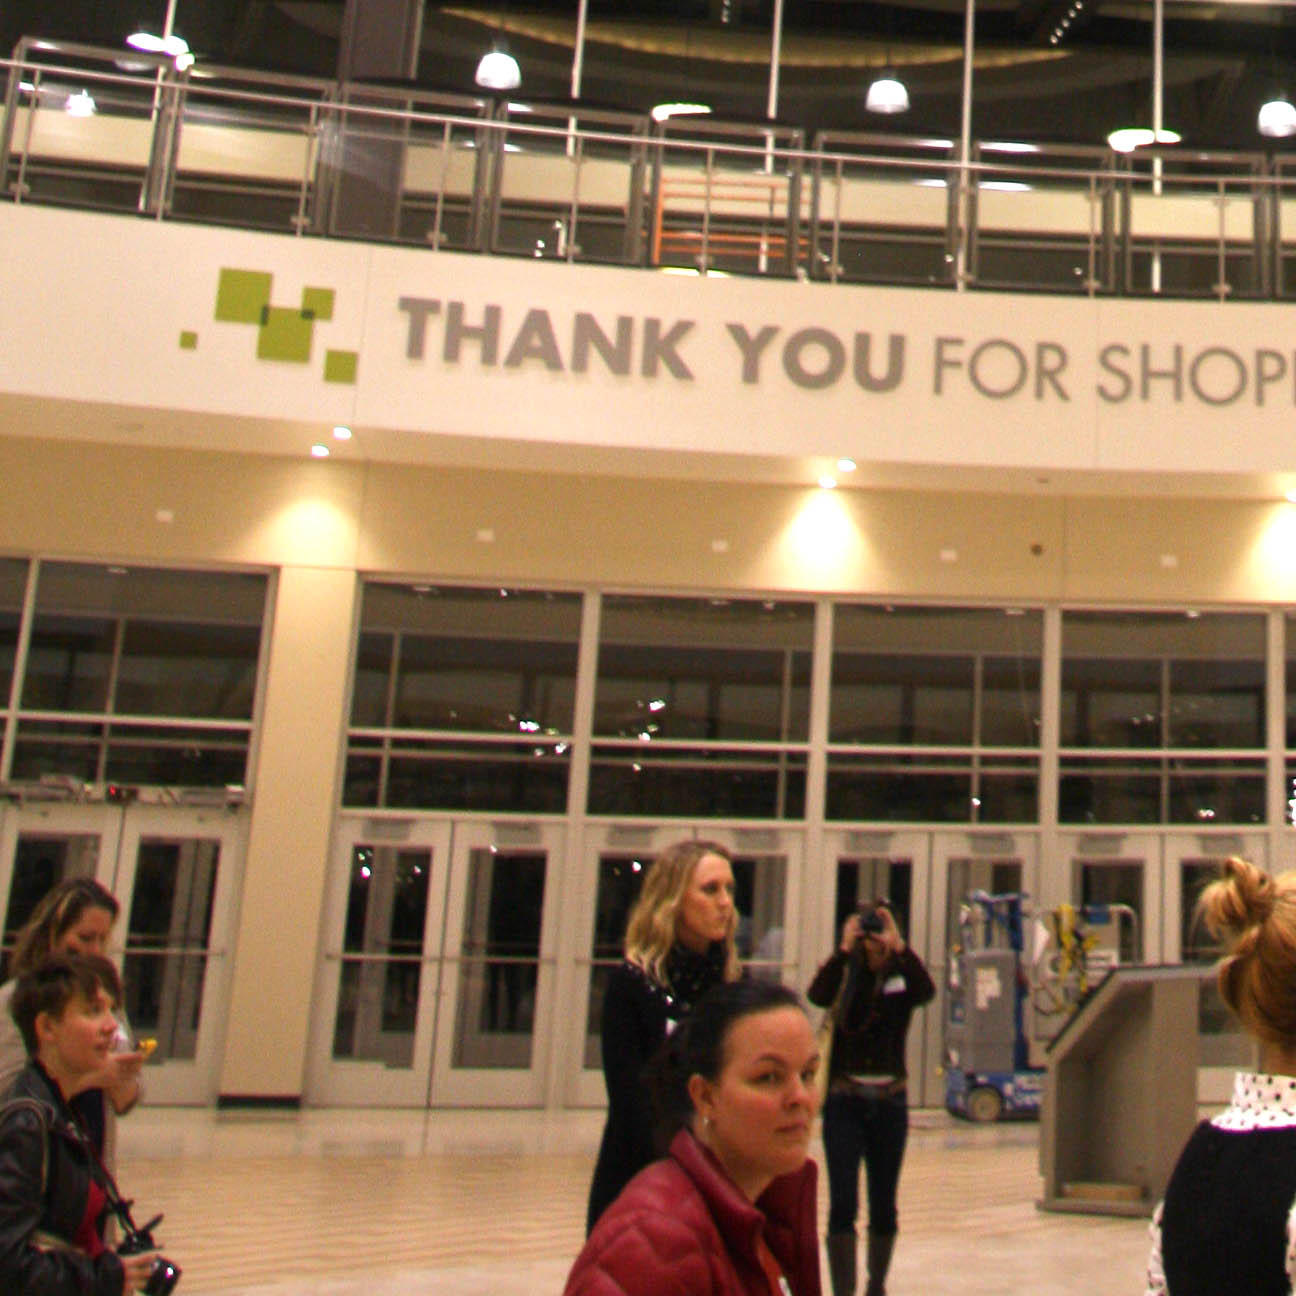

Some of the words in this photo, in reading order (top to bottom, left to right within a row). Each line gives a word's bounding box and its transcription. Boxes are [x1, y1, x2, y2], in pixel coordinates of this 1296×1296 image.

[400, 297, 696, 381] THANK
[727, 324, 905, 394] YOU
[933, 337, 1070, 402] FOR
